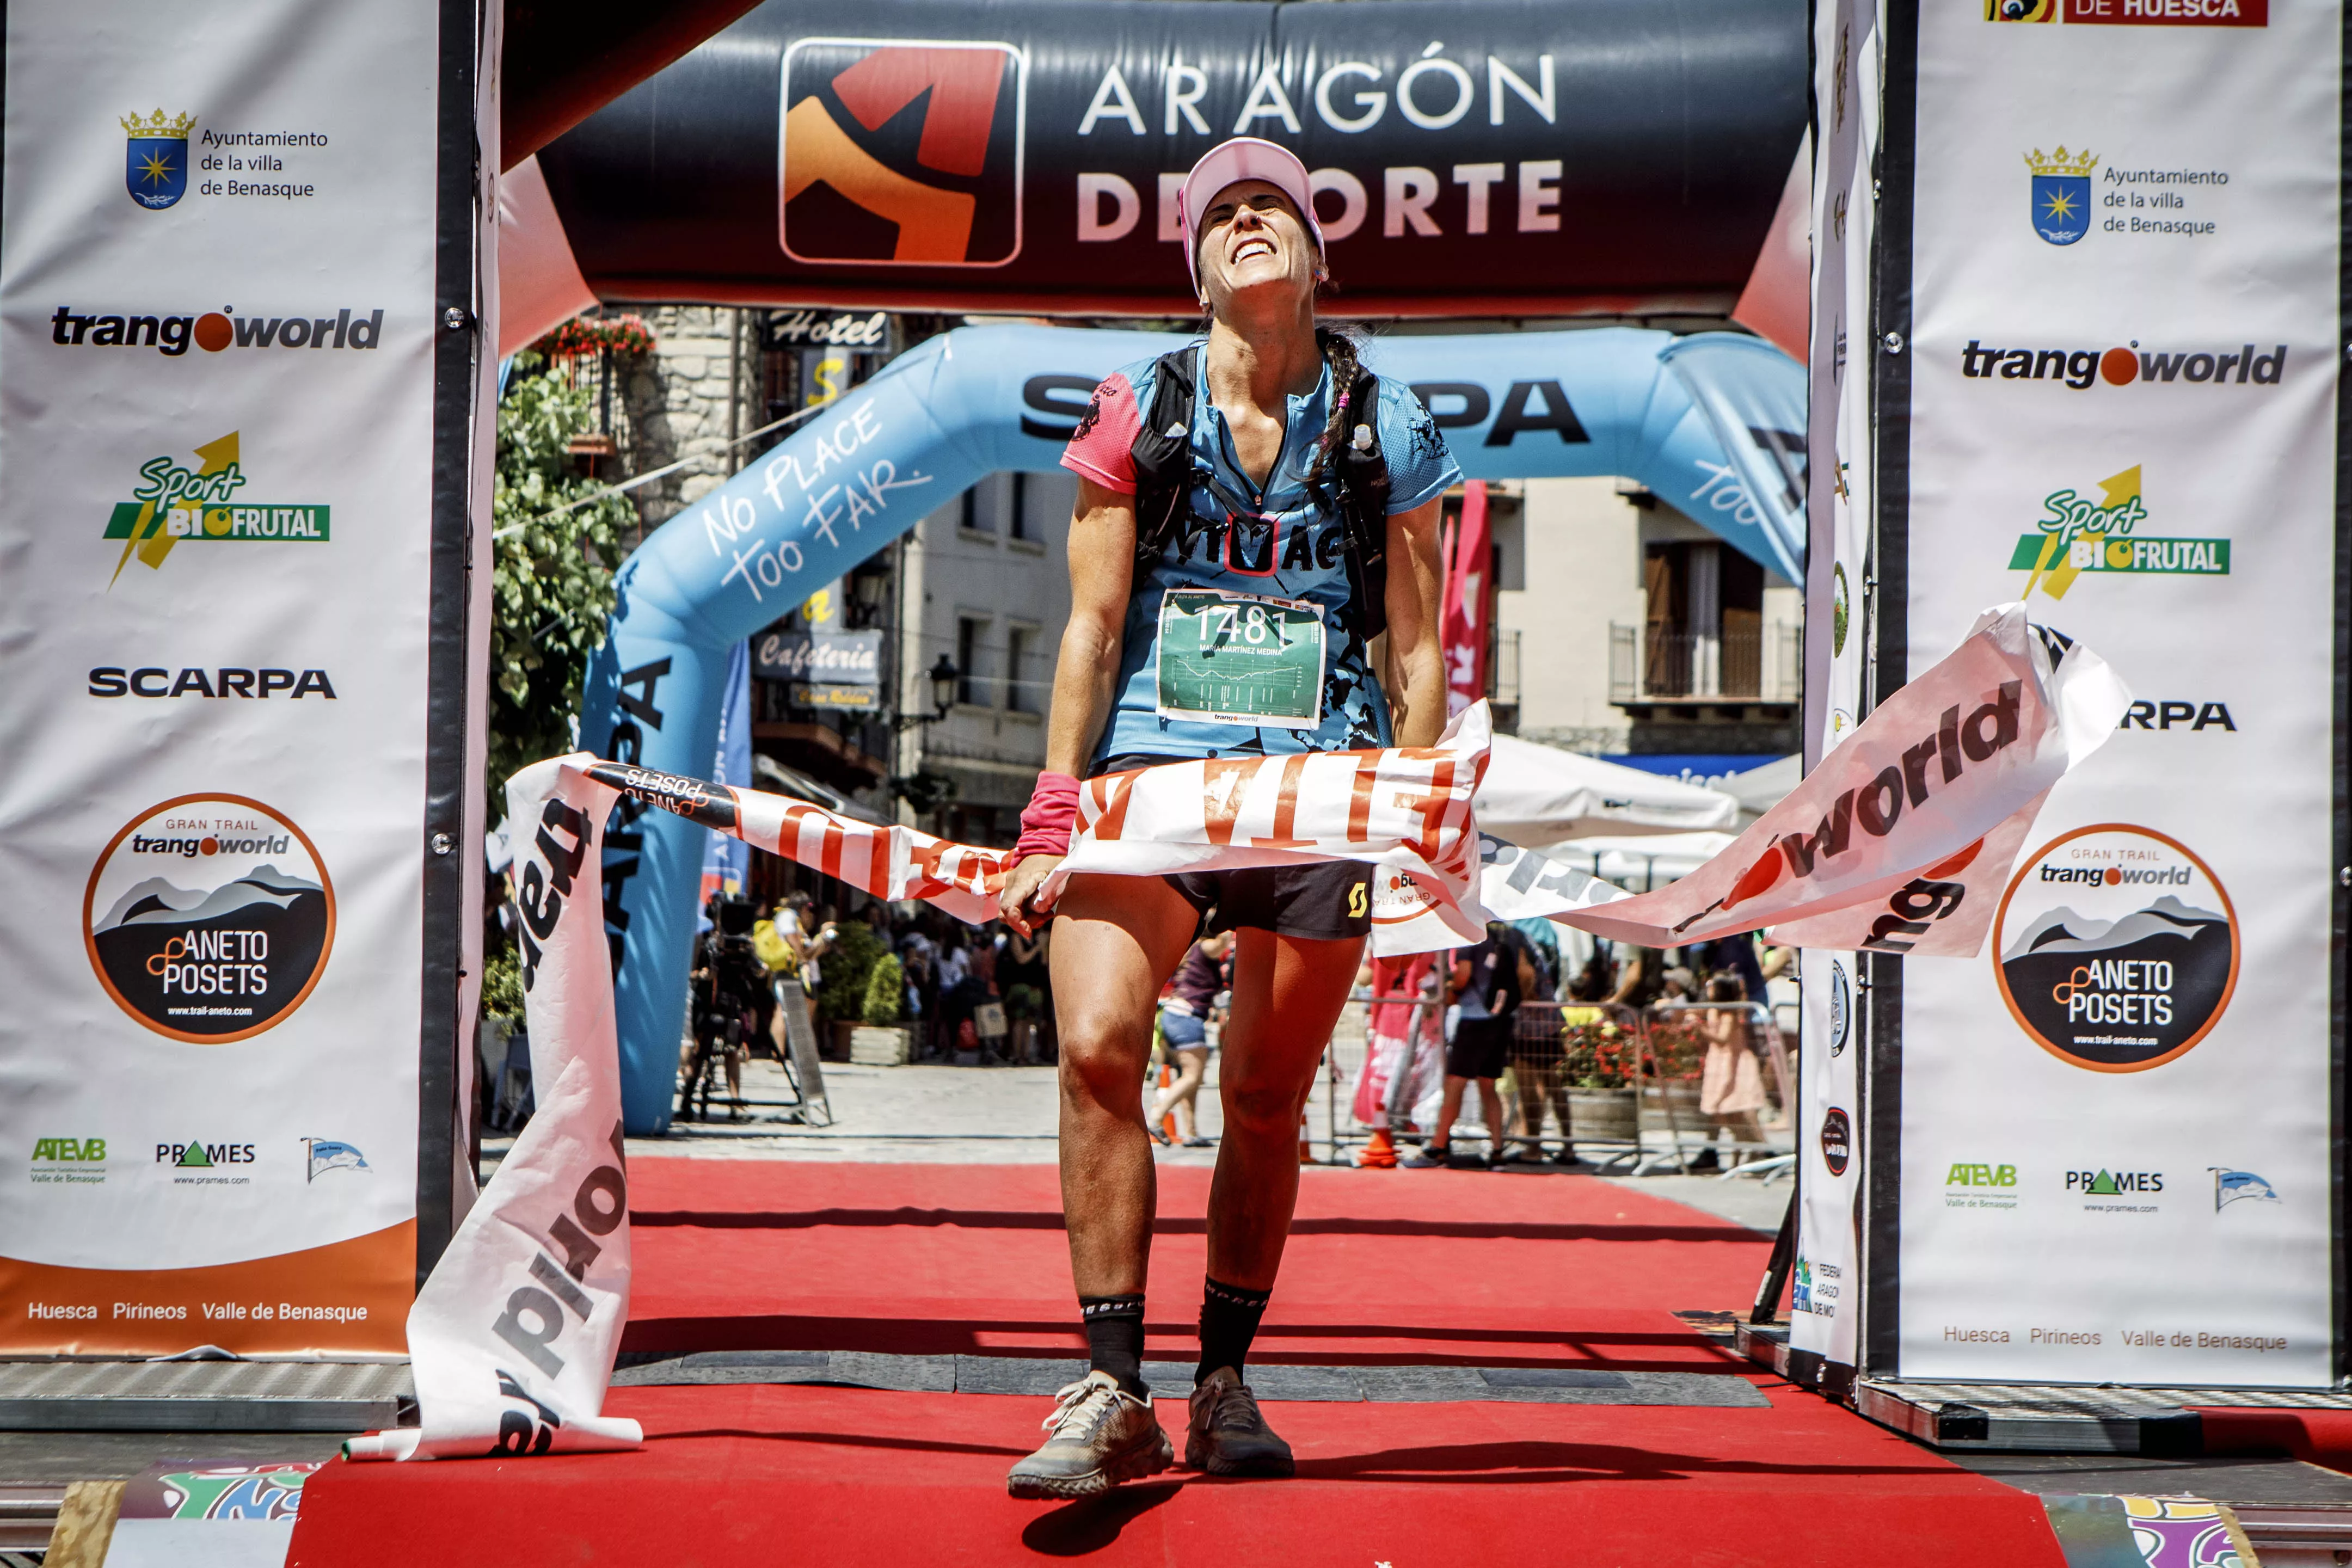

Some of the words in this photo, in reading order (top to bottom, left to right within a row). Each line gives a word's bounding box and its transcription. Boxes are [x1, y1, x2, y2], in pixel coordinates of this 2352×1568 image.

[2076, 0, 2112, 16] DE
[2123, 0, 2240, 17] HUESCA
[1078, 40, 1557, 136] ARAGÓN
[201, 129, 328, 148] Ayuntamiento
[201, 155, 223, 171] de
[228, 155, 243, 171] la
[248, 155, 283, 171] villa
[2104, 167, 2228, 186] Ayuntamiento
[200, 180, 223, 196] de
[228, 181, 314, 200] Benasque
[1077, 160, 1562, 243] DEORTE
[2104, 193, 2126, 207] de
[2130, 193, 2145, 208] la
[2150, 194, 2184, 209] villa
[2104, 217, 2125, 232] de
[2131, 217, 2215, 237] Benasque
[769, 310, 883, 345] Hotel
[1021, 374, 1589, 446] SPA
[764, 398, 882, 511] PLACE
[134, 457, 245, 512] Sport
[167, 506, 321, 537] BIOFRUTAL
[2038, 489, 2147, 545] Sport
[2070, 539, 2222, 570] BIOFRUTAL
[1195, 605, 1287, 647] 1481
[1200, 644, 1220, 652] MARÍA
[1222, 644, 1255, 654] MARTÍNEZ
[1257, 647, 1282, 656] MEDINA
[88, 667, 337, 699] SCARPA
[2116, 699, 2238, 731] RPA
[624, 768, 703, 799] POSETS
[166, 819, 207, 830] GRAN
[214, 820, 258, 830] TRAIL
[2072, 848, 2111, 860] GRAN
[2117, 850, 2160, 861] TRAIL
[185, 930, 268, 961] ANETO
[163, 964, 267, 994] POSETS
[2089, 959, 2172, 991] ANETO
[168, 1006, 253, 1016] www.trail-aneto.com
[2069, 993, 2172, 1025] POSETS
[2074, 1035, 2158, 1045] www.trail-aneto.com
[31, 1137, 106, 1161] ATEVB
[156, 1140, 255, 1167] PRAMES
[31, 1174, 52, 1183] Valle
[53, 1174, 64, 1183] de
[66, 1174, 106, 1185] Benasque
[174, 1176, 250, 1185] www.prames.com
[1946, 1163, 2017, 1187] ATEVB
[2066, 1169, 2163, 1195] PRAMES
[1945, 1198, 1966, 1207] Valle
[1967, 1199, 1978, 1208] de
[1979, 1200, 2018, 1210] Benasque
[2084, 1204, 2158, 1213] www.prames.com
[493, 1164, 627, 1380] orld
[28, 1302, 97, 1319] Huesca
[113, 1302, 187, 1319] Pirineos
[202, 1302, 246, 1319] Valle
[251, 1302, 273, 1320] de
[279, 1303, 367, 1324] Benasque
[1944, 1326, 2010, 1343] Huesca
[2030, 1328, 2102, 1345] Pirineos
[2121, 1330, 2165, 1347] Valle
[2170, 1331, 2192, 1348] de
[2197, 1332, 2287, 1352] Benasque
